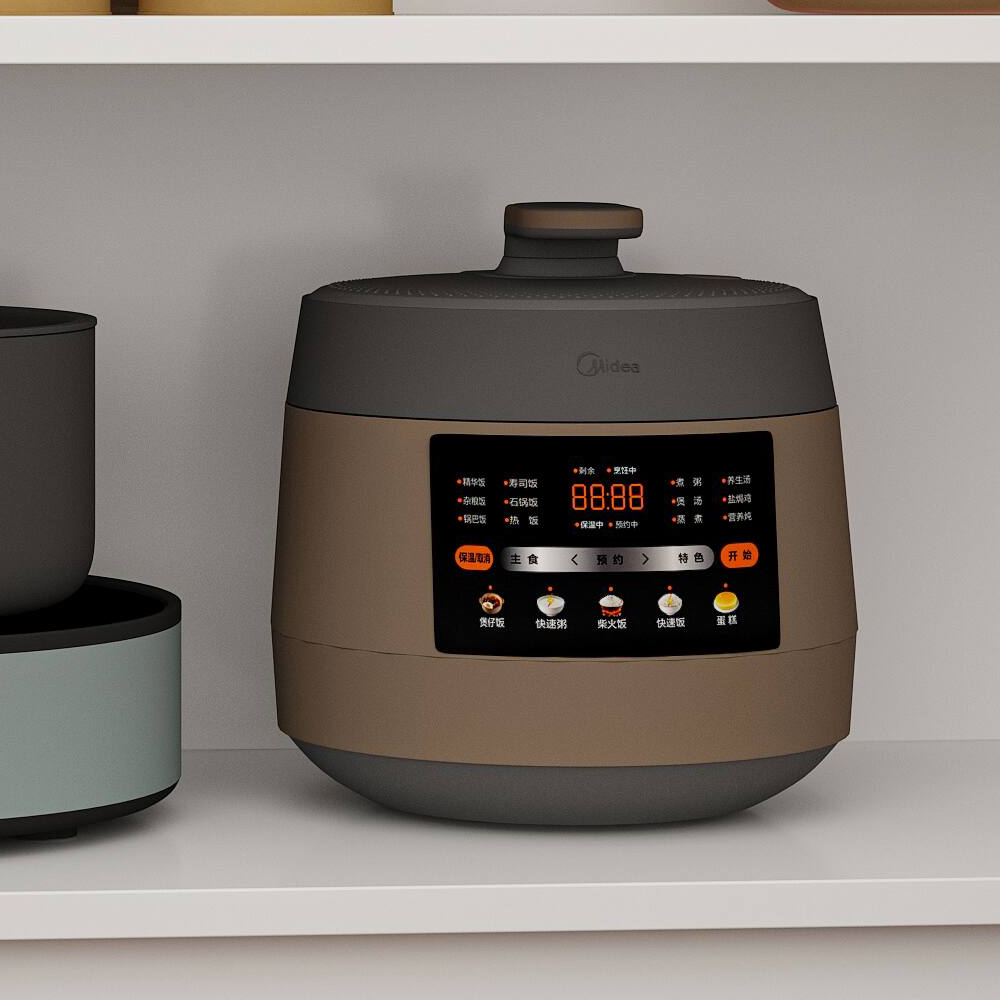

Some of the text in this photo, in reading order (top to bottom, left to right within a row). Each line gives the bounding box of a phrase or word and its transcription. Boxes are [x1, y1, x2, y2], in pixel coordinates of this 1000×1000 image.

[577, 352, 641, 377] Midea
[579, 467, 596, 475] 剩余
[613, 466, 637, 475] 烹饪中
[509, 497, 539, 508] 石锅饭
[571, 483, 644, 511] 88:88
[580, 520, 604, 529] 保温中
[615, 520, 639, 529] 预约中
[535, 618, 567, 630] 快速粥
[597, 618, 627, 630] 柴火饭
[656, 617, 686, 628] 快速饭
